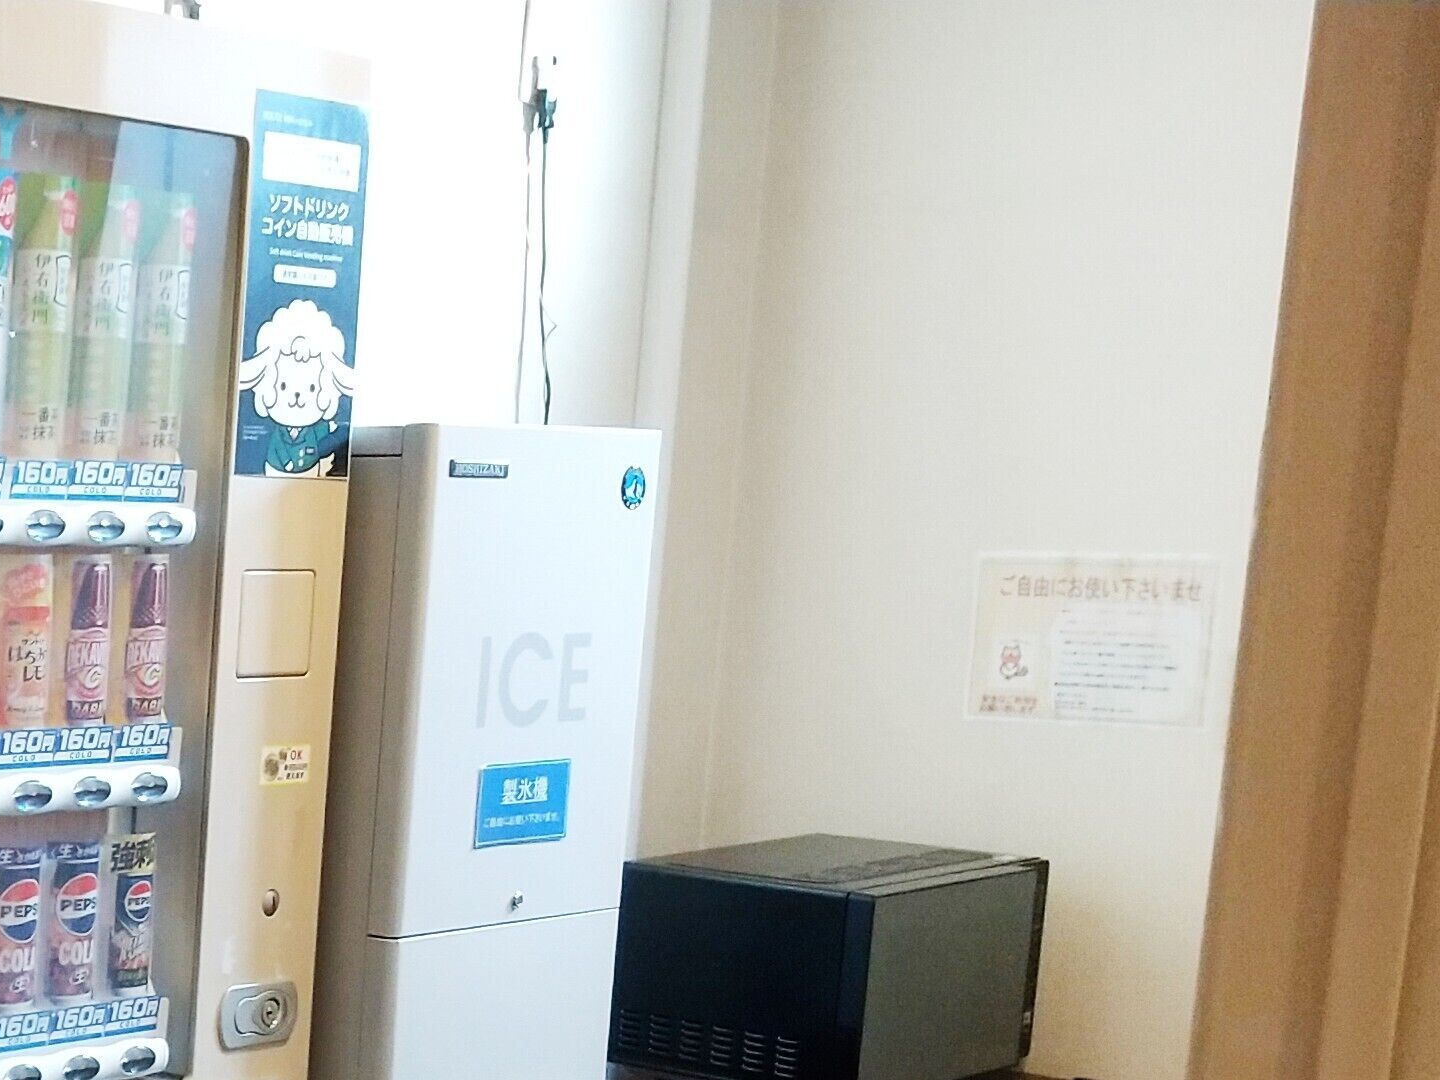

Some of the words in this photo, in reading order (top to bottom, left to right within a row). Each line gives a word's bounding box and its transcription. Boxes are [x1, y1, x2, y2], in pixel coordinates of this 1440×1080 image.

[268, 192, 350, 221] ソフトドリンク
[27, 485, 51, 493] COLD
[83, 486, 107, 494] COLD
[139, 487, 162, 496] COLD
[476, 632, 592, 728] ICE
[69, 750, 93, 759] COLD
[129, 746, 153, 755] COLD
[12, 754, 36, 762] COLD
[502, 776, 549, 805] 製氷機
